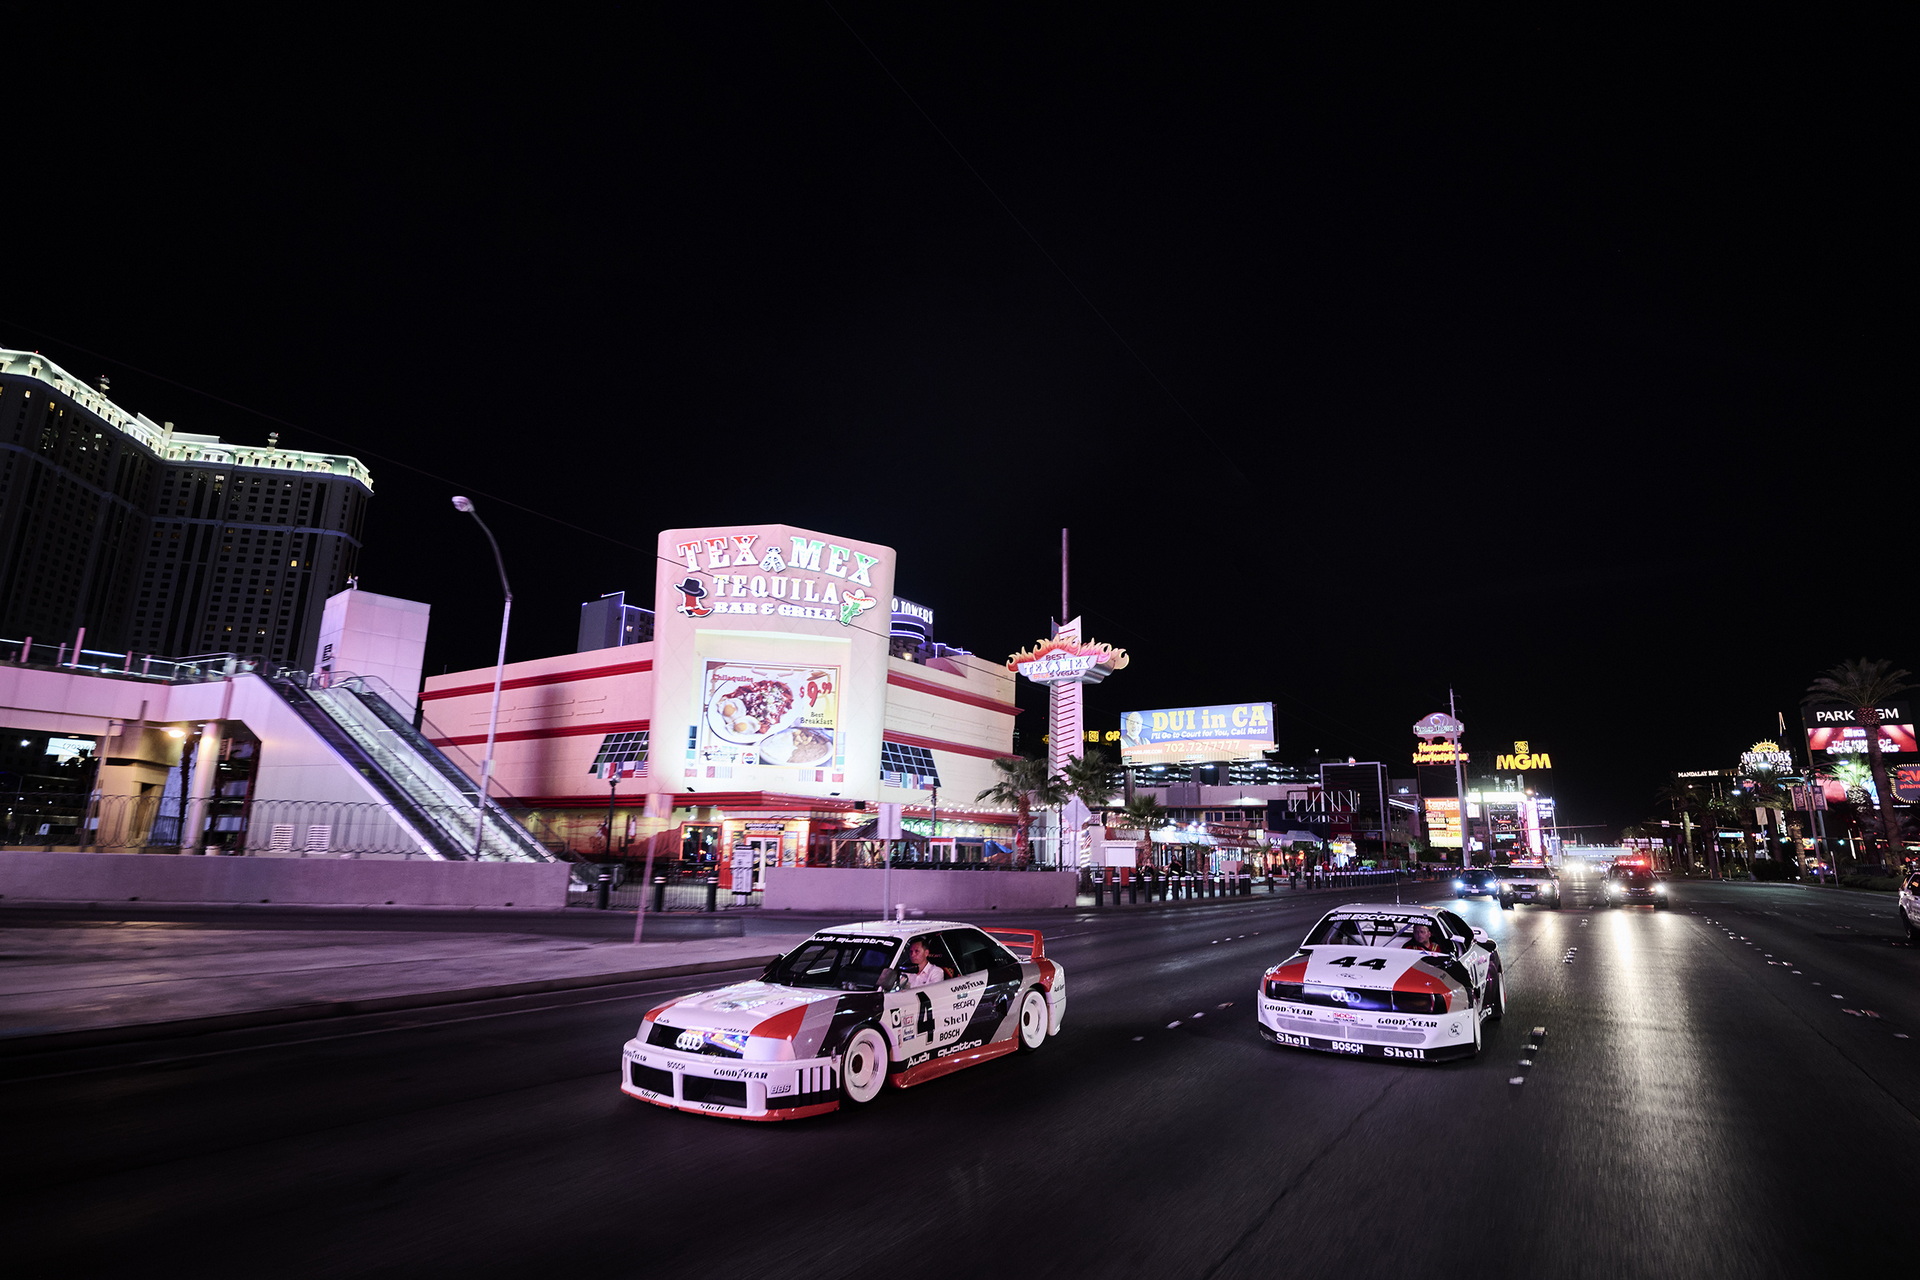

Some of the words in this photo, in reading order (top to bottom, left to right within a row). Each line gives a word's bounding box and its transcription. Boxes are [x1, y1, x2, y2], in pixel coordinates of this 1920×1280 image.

[676, 534, 759, 573] TEX
[787, 536, 879, 587] MEX
[713, 574, 840, 605] TEQUILA
[713, 602, 758, 614] BAR
[760, 603, 775, 615] &
[778, 604, 837, 621] GRILL
[900, 600, 933, 625] TOWERS
[1046, 653, 1067, 661] BEST
[1023, 661, 1050, 675] TEX
[1060, 656, 1090, 673] MEX
[800, 717, 833, 725] Breakfast
[1152, 710, 1196, 731] DUI
[1201, 709, 1226, 729] in
[1231, 705, 1268, 727] CA
[1816, 709, 1856, 722] PARK
[1874, 708, 1900, 719] GM
[1214, 729, 1230, 737] You,
[1247, 727, 1268, 735] Reza!
[1164, 740, 1241, 753] 702.727.7777
[1832, 740, 1850, 748] THE
[1851, 739, 1868, 747] KIN
[1878, 738, 1892, 748] OF
[1496, 753, 1551, 770] MGM
[1743, 752, 1765, 763] NEW
[1766, 751, 1792, 762] YORK
[836, 937, 895, 947] quattro
[1327, 956, 1387, 970] 44
[953, 999, 976, 1010] RECARO
[916, 991, 935, 1045] 4
[943, 1012, 968, 1027] Shell
[939, 1028, 960, 1042] BOSCH
[1276, 1032, 1310, 1046] Shell
[906, 1052, 930, 1069] Audi
[937, 1039, 982, 1057] quattro
[1332, 1041, 1364, 1053] BOSCH
[1383, 1046, 1425, 1059] Shell
[700, 1102, 726, 1112] Shell
